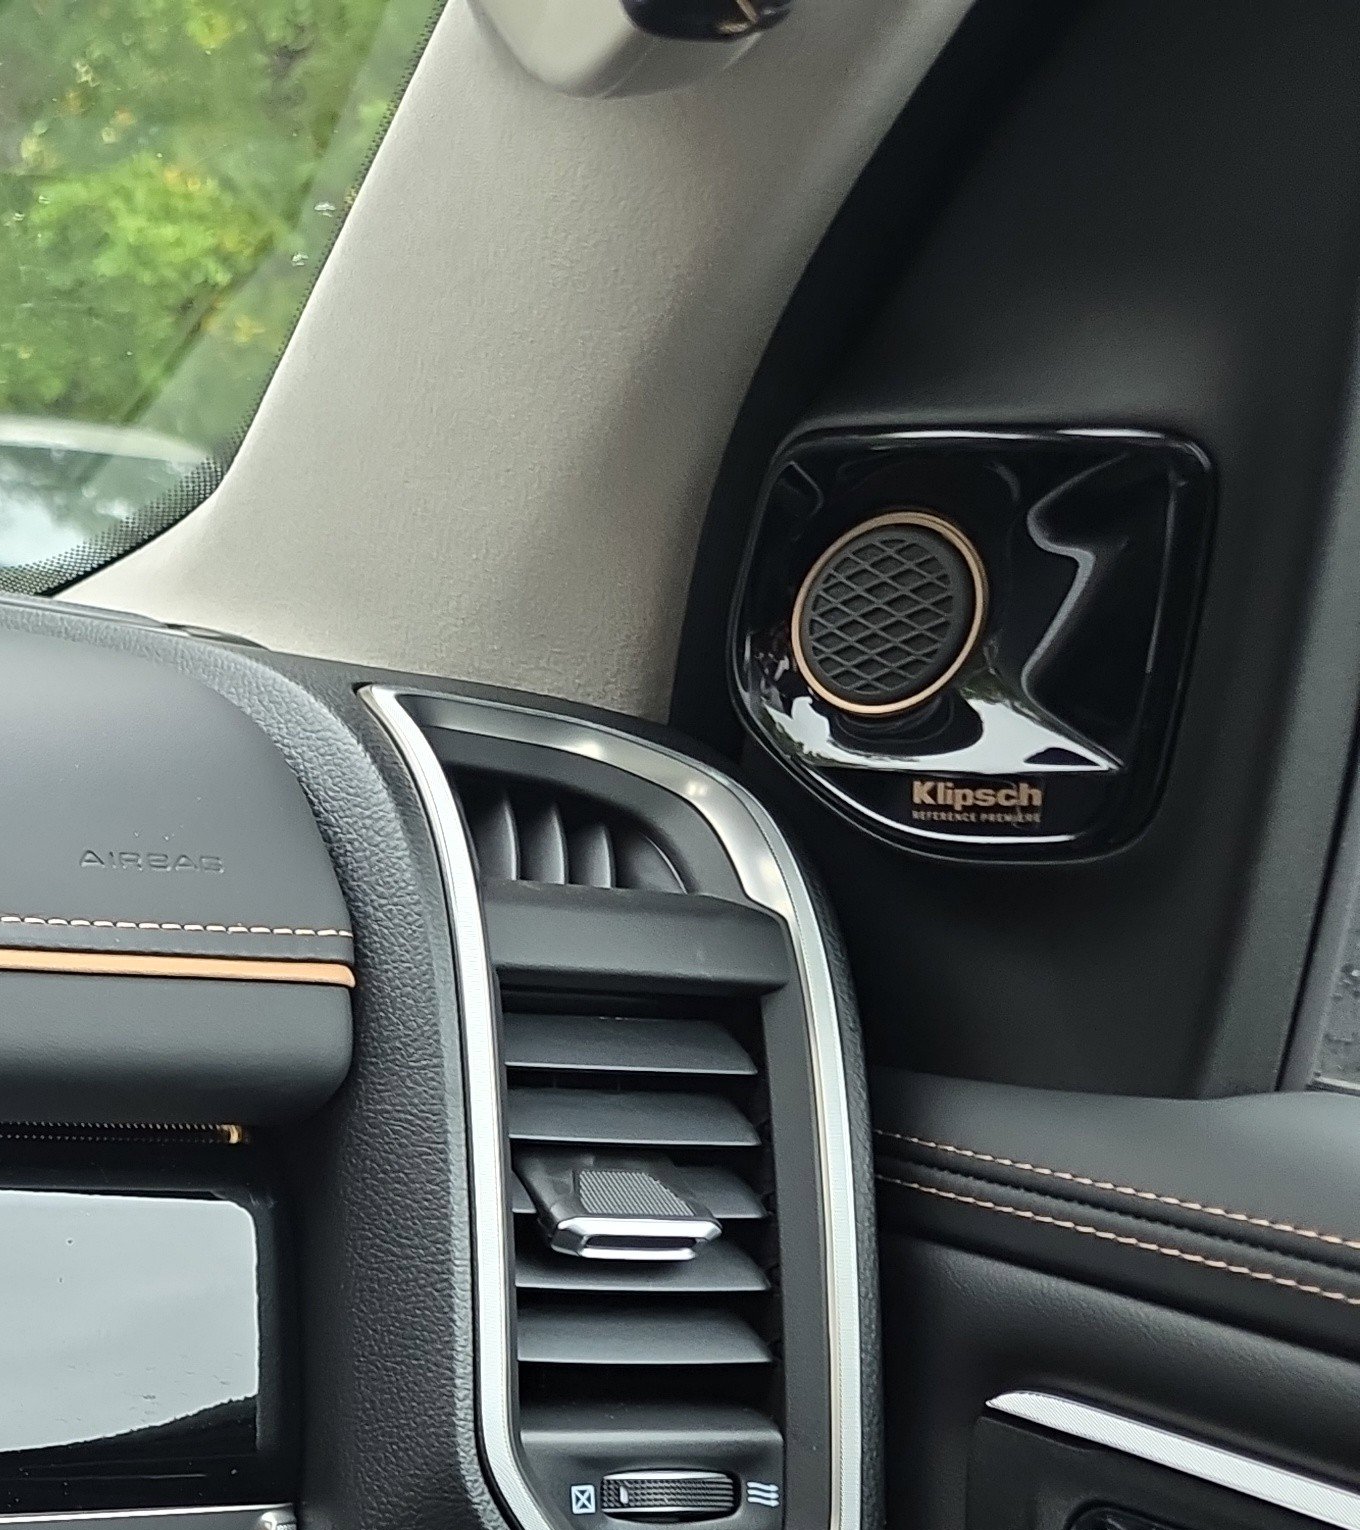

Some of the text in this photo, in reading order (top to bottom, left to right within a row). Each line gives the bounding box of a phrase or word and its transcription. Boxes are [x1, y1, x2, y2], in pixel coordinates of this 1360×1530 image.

[913, 781, 1042, 811] Klipsch
[912, 810, 977, 822] REFERENCE
[79, 849, 225, 873] AIRBAG
